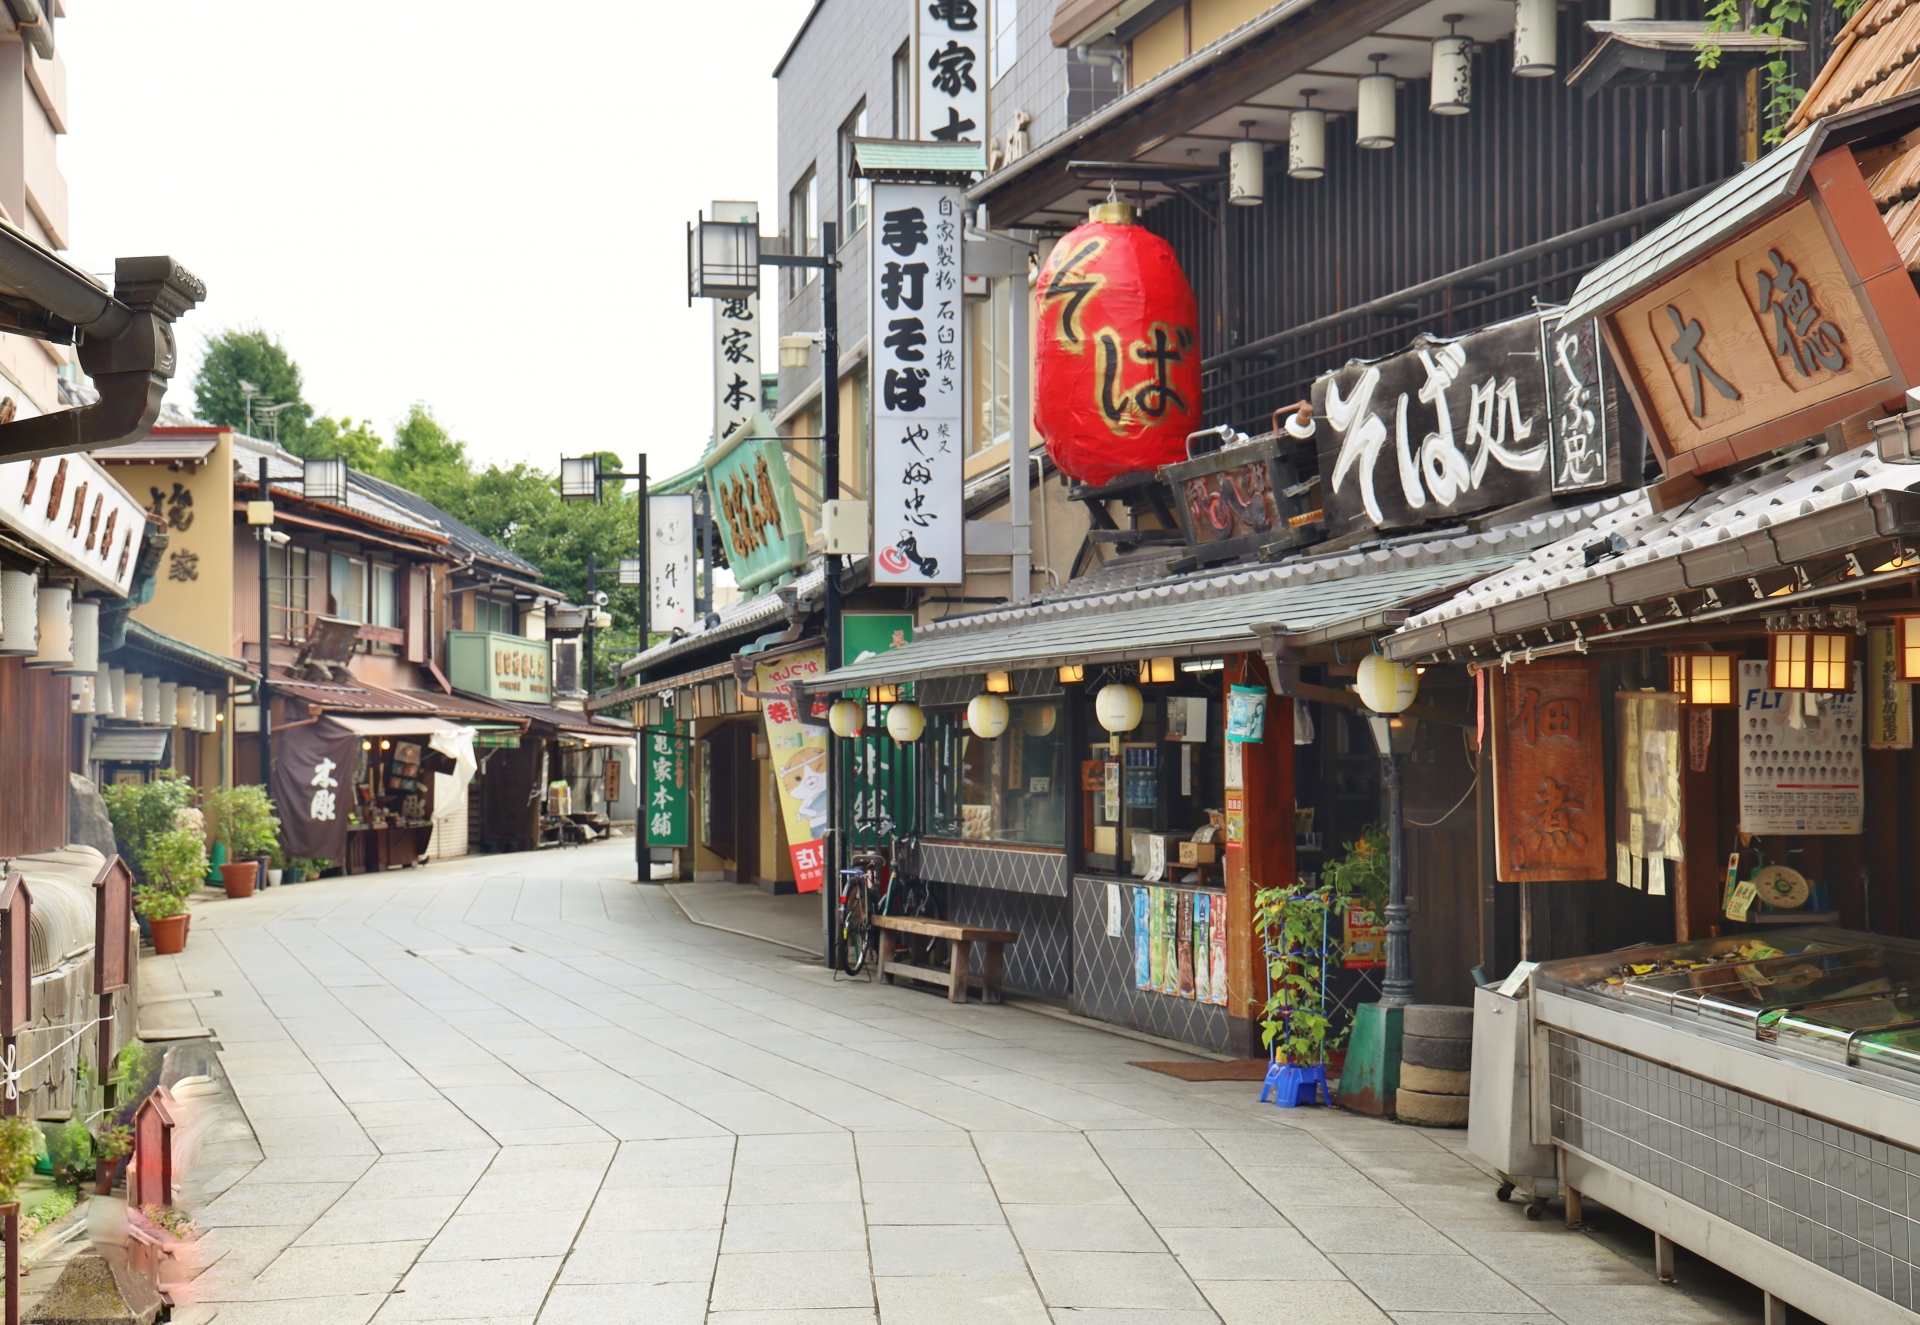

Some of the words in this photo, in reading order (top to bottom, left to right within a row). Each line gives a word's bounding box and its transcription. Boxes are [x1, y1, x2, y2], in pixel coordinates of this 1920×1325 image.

[880, 206, 931, 412] 手打そば
[1044, 238, 1194, 424] そば
[936, 422, 951, 454] 柴又
[1325, 342, 1549, 526] そば処
[310, 757, 339, 822] 木彫
[1511, 688, 1590, 851] 佃煮
